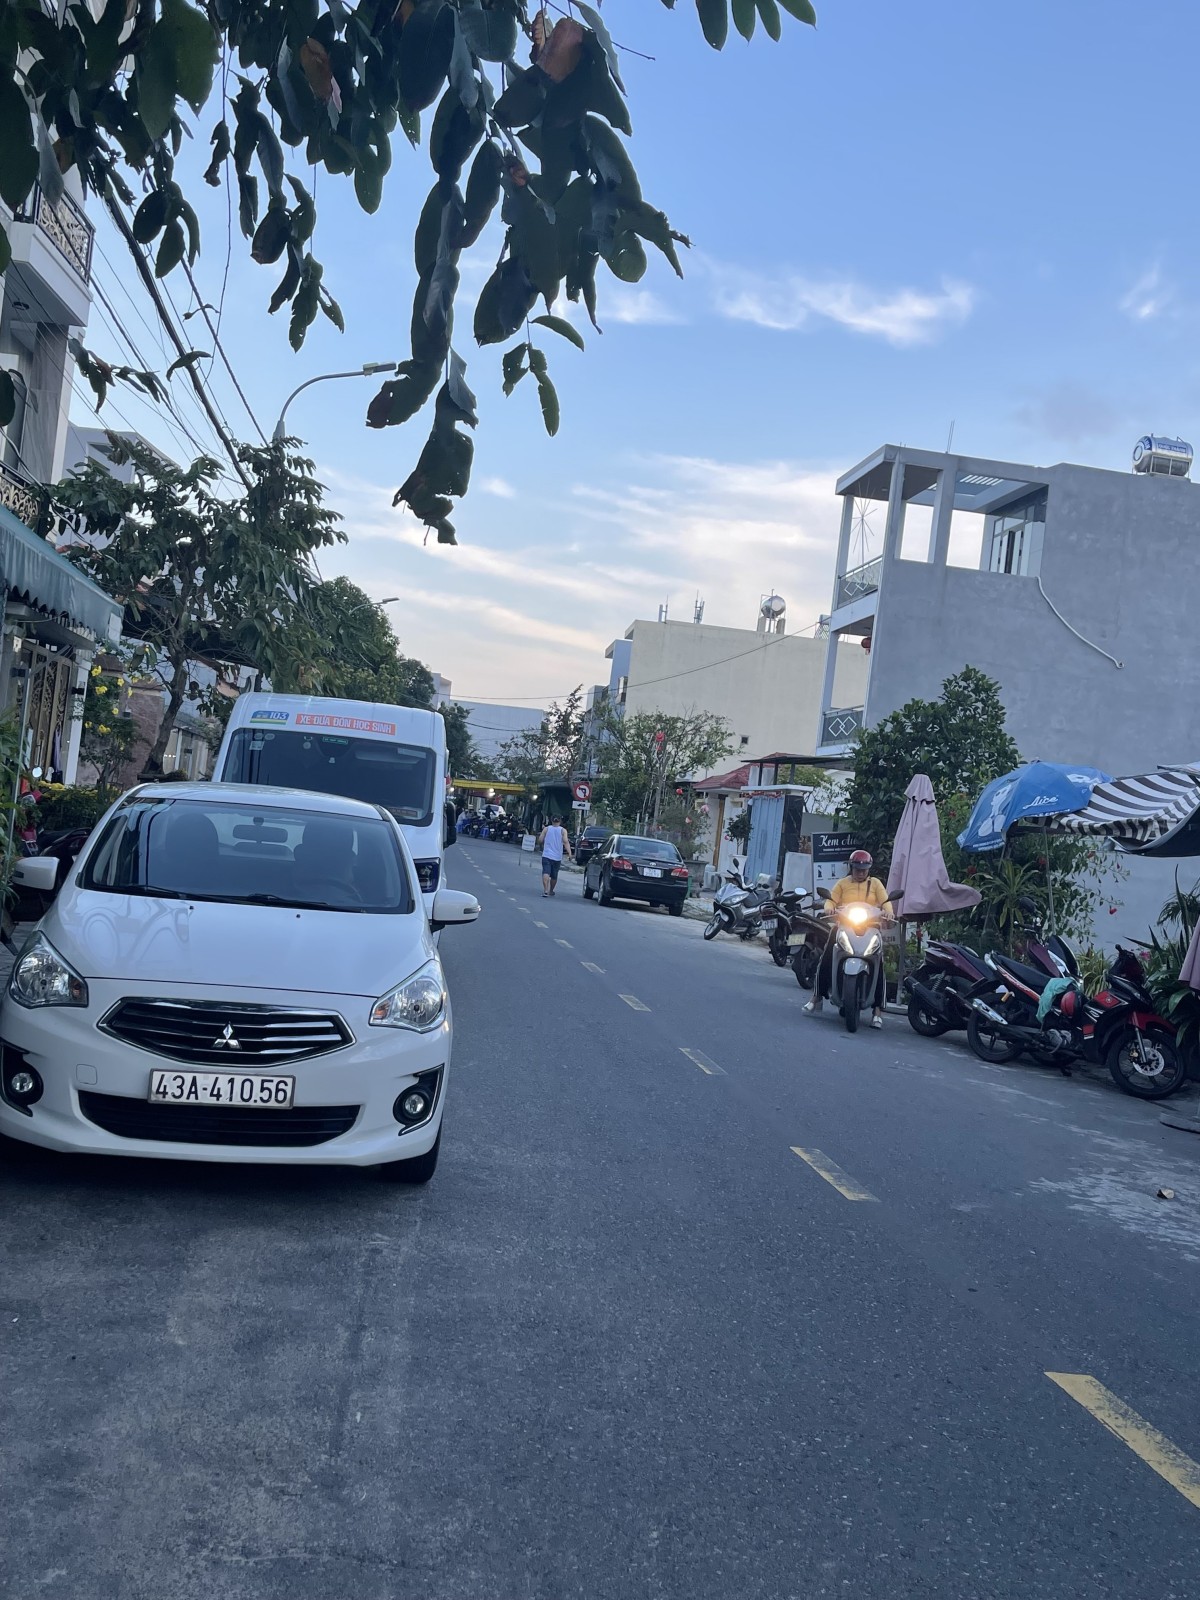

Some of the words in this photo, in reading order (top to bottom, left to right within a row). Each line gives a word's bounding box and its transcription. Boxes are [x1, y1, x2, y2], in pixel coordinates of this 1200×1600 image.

[269, 711, 288, 720] 103
[300, 714, 311, 724] XE
[372, 722, 392, 734] SINH
[818, 834, 839, 847] Kem
[155, 1073, 289, 1104] 43A-410.56
